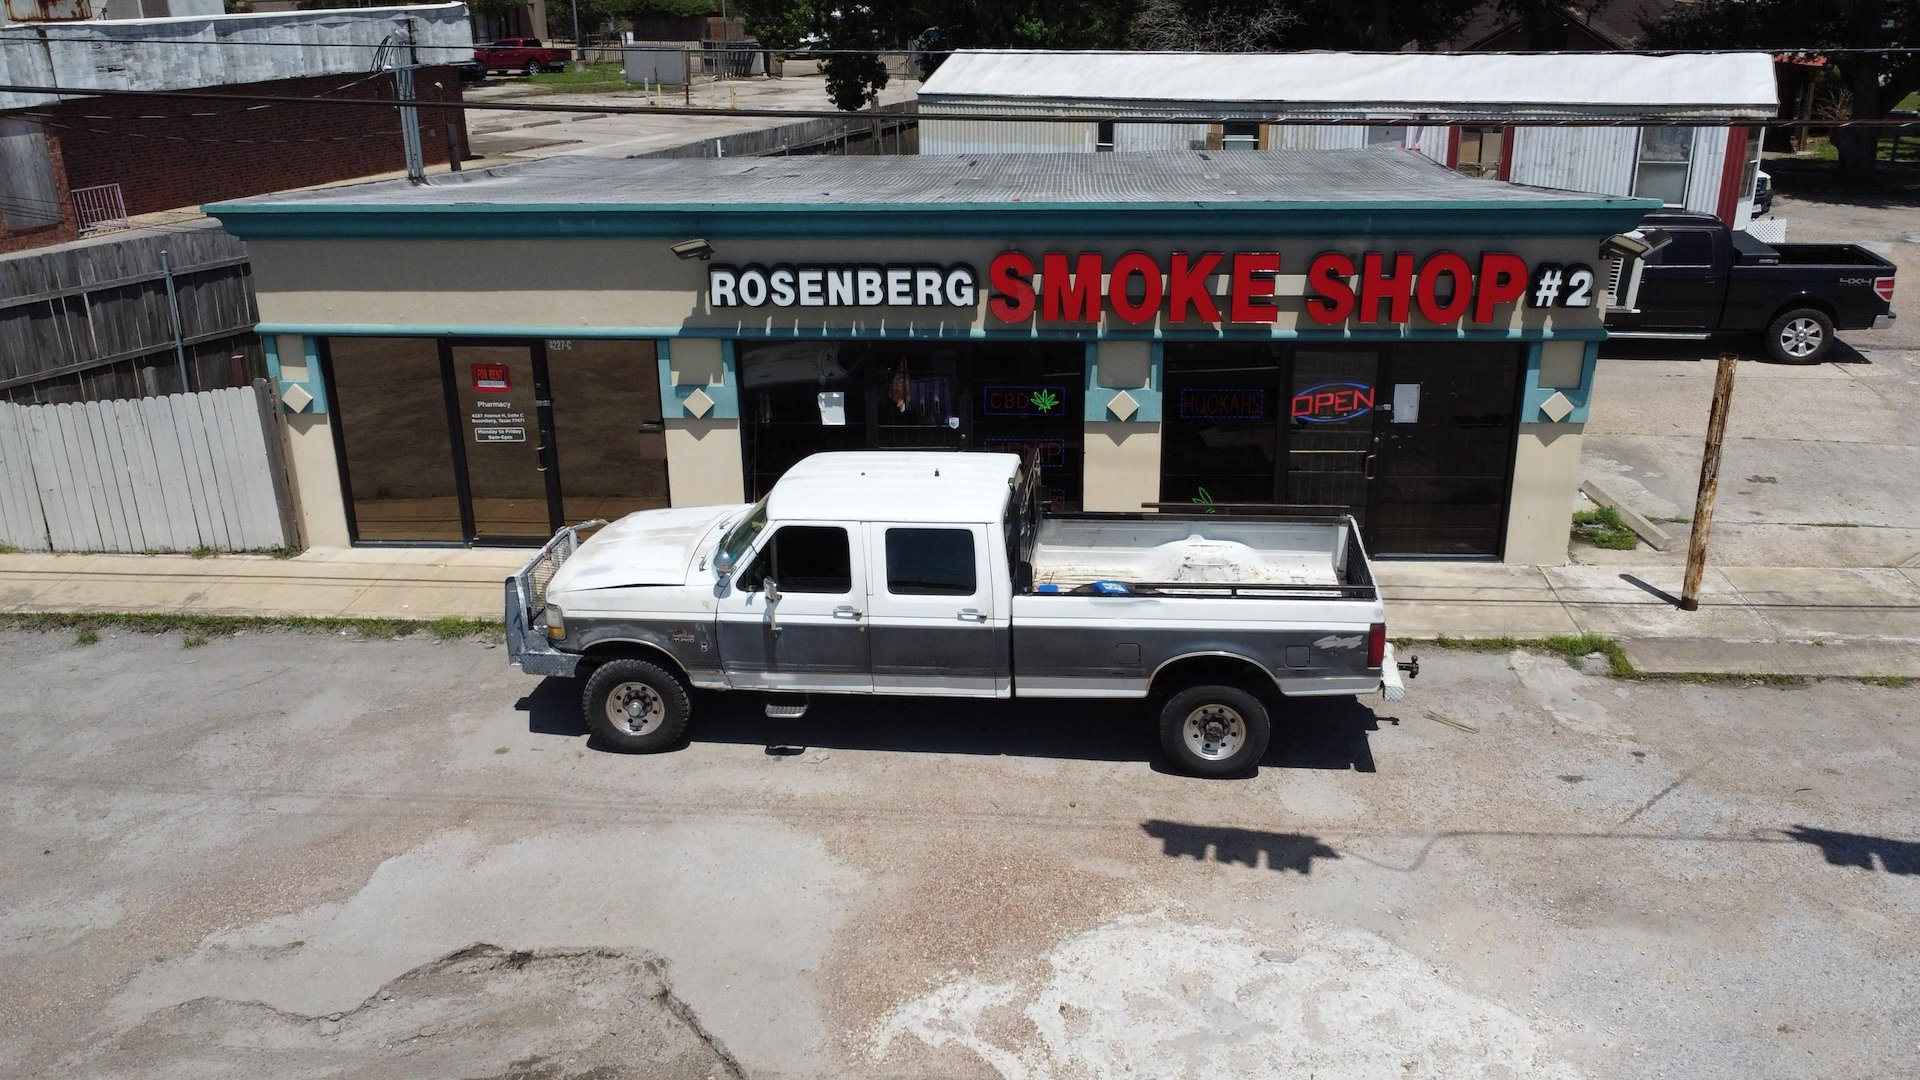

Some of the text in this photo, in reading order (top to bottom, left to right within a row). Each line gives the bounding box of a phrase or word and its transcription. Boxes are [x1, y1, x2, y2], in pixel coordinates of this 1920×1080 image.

[711, 251, 1595, 325] ROSENBERG SMOKE SHOP #2
[549, 340, 572, 351] 4227-C
[477, 368, 503, 380] FOR RENT
[477, 401, 511, 409] Pharmacy
[991, 393, 1029, 409] CBD
[1184, 392, 1261, 415] HOOKAHS
[1291, 387, 1375, 417] OPEN
